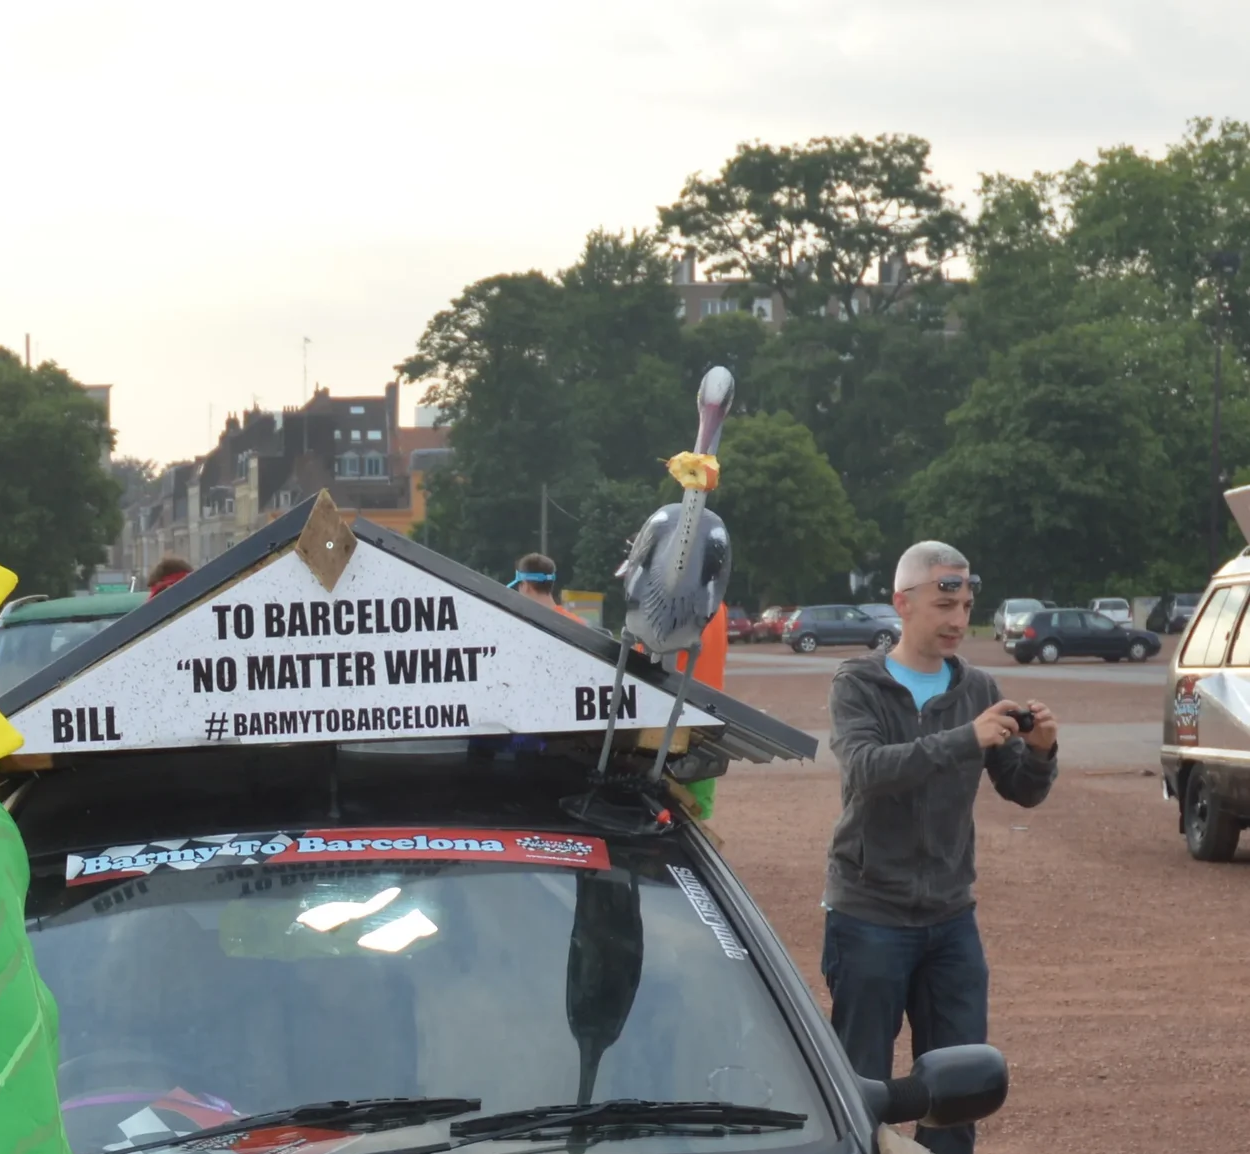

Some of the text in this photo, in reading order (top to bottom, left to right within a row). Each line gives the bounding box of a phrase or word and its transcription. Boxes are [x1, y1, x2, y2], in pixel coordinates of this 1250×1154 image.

[212, 596, 459, 640] TO BARCELONA
[247, 650, 376, 691] MATTER
[575, 684, 637, 721] BEN
[52, 706, 121, 743] BILL
[82, 845, 220, 876] Barmy
[233, 840, 288, 858] To
[296, 835, 505, 853] Barcelona
